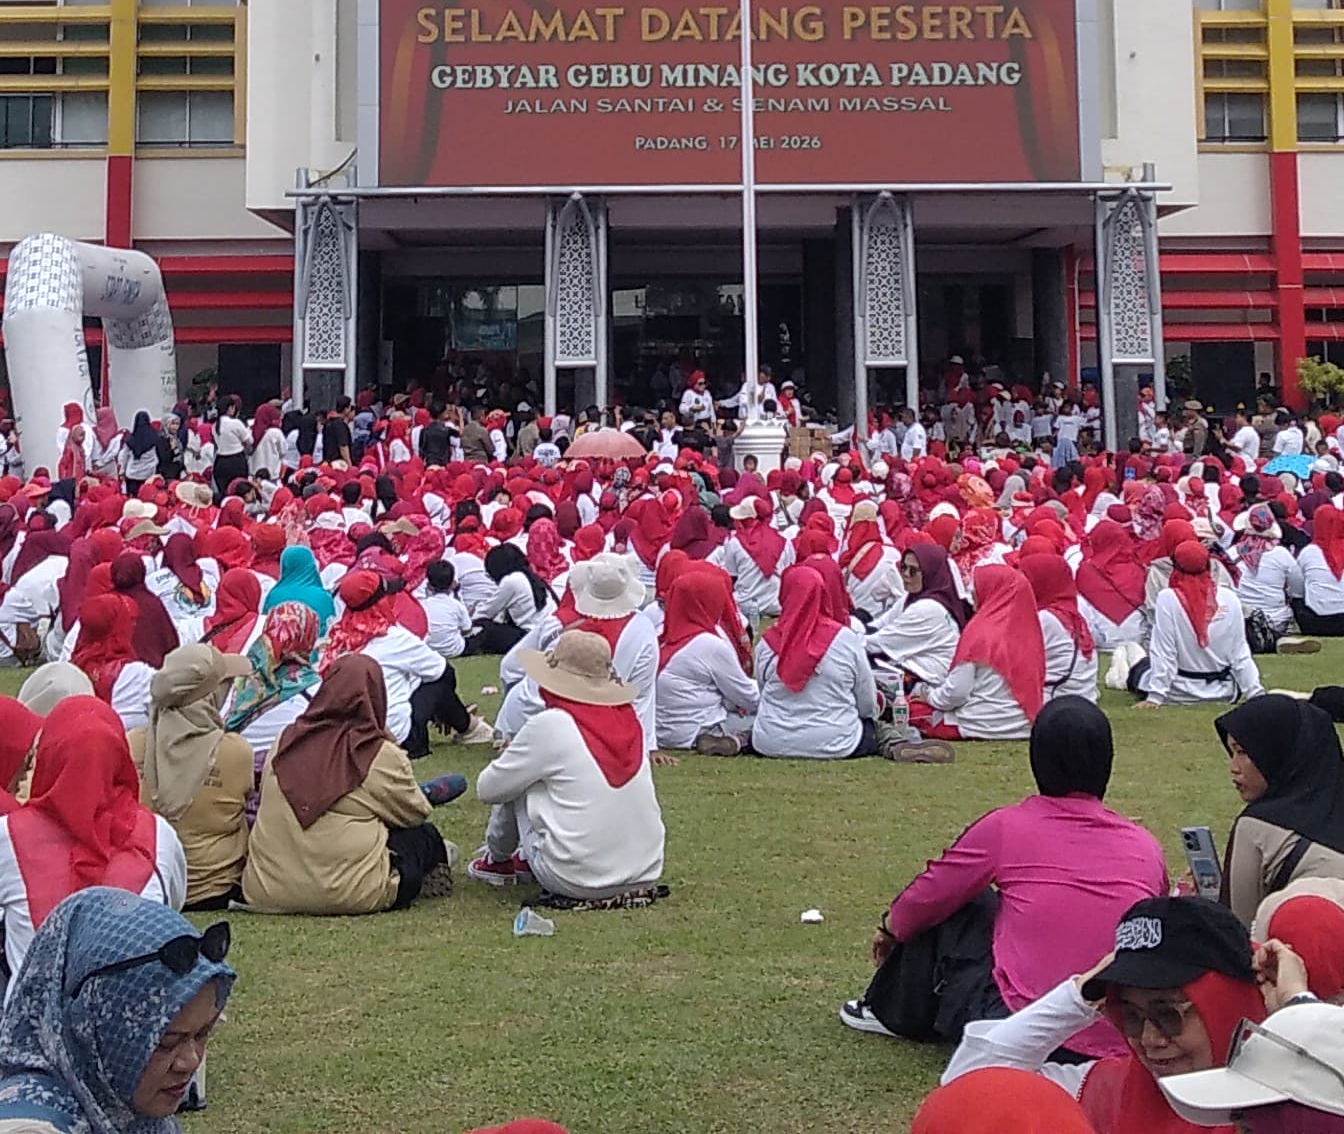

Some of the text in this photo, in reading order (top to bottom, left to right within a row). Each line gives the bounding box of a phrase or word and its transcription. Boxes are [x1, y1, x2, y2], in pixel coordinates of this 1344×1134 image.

[416, 5, 1034, 44] SELAMAT DATANG PESERTA
[431, 61, 1023, 89] GEBYAR GEBU MINANG KOTA PADANG
[504, 96, 953, 113] JALAN SANTAI & SENAM MASSAL
[634, 136, 711, 151] PADANG,
[719, 136, 737, 149] 17
[780, 135, 821, 149] 2026
